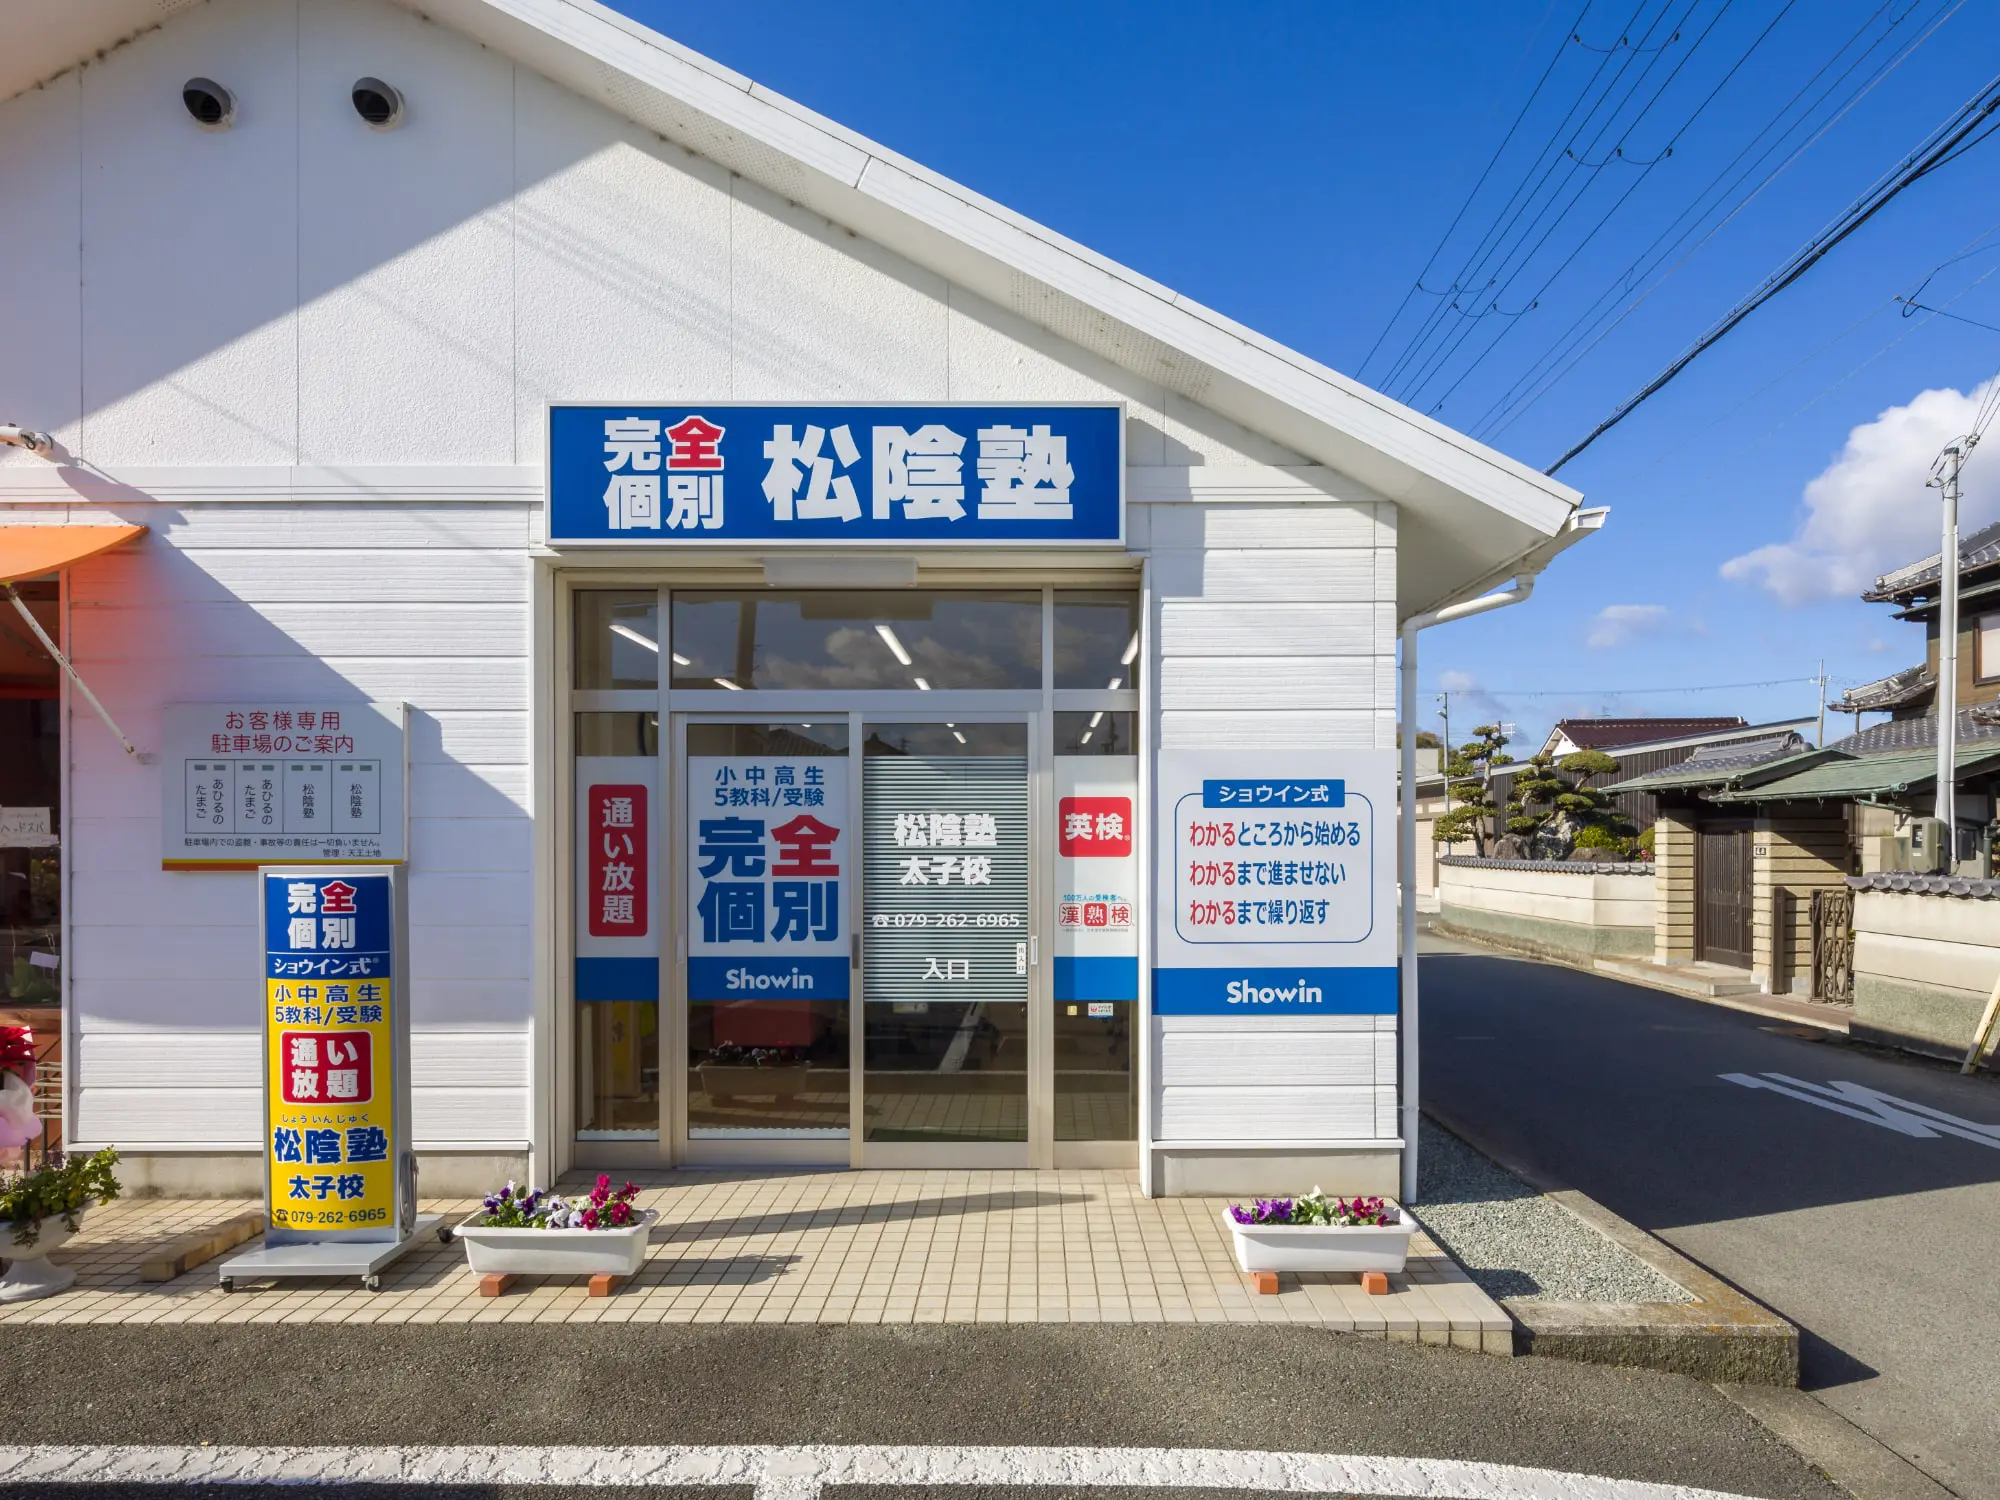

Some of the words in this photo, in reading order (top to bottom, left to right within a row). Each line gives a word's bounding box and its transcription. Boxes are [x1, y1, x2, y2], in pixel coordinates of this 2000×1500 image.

[603, 415, 725, 472] 完全
[761, 424, 1075, 522] 松陰塾
[603, 474, 724, 530] 個別
[225, 711, 340, 731] お客様専用
[211, 734, 354, 754] 駐車場のご案内
[715, 765, 825, 786] 小中高生
[195, 784, 207, 819] たまご
[212, 779, 224, 825] あひるの
[244, 784, 256, 819] たまご
[261, 779, 273, 825] あひるの
[302, 784, 315, 819] 松陰塾
[350, 784, 362, 819] 松陰塾
[714, 787, 825, 807] 5教科/受験
[1218, 784, 1329, 803] ショウイン式
[893, 813, 998, 848] 松陰塾
[1189, 821, 1361, 847] わかるところから始める
[602, 797, 634, 924] 通い放題
[697, 814, 840, 879] 完全
[899, 856, 992, 885] 太子校
[1189, 860, 1346, 886] わかるまで進ませない
[287, 880, 357, 914] 完全
[697, 880, 839, 943] 個別
[1189, 899, 1330, 925] わかるまで繰り返す
[287, 917, 356, 949] 個別
[894, 913, 1020, 928] 079-262-6965
[726, 967, 814, 989] Showin
[922, 957, 970, 980] 入口
[274, 983, 382, 1004] 小中高生
[1226, 979, 1322, 1004] Showin
[275, 1004, 383, 1026] 5教科/受験
[290, 1037, 358, 1067] 通い
[291, 1069, 359, 1099] 放題
[273, 1126, 389, 1165] 松陰塾
[288, 1174, 365, 1200] 太子校
[291, 1207, 386, 1224] 079-262-6965
